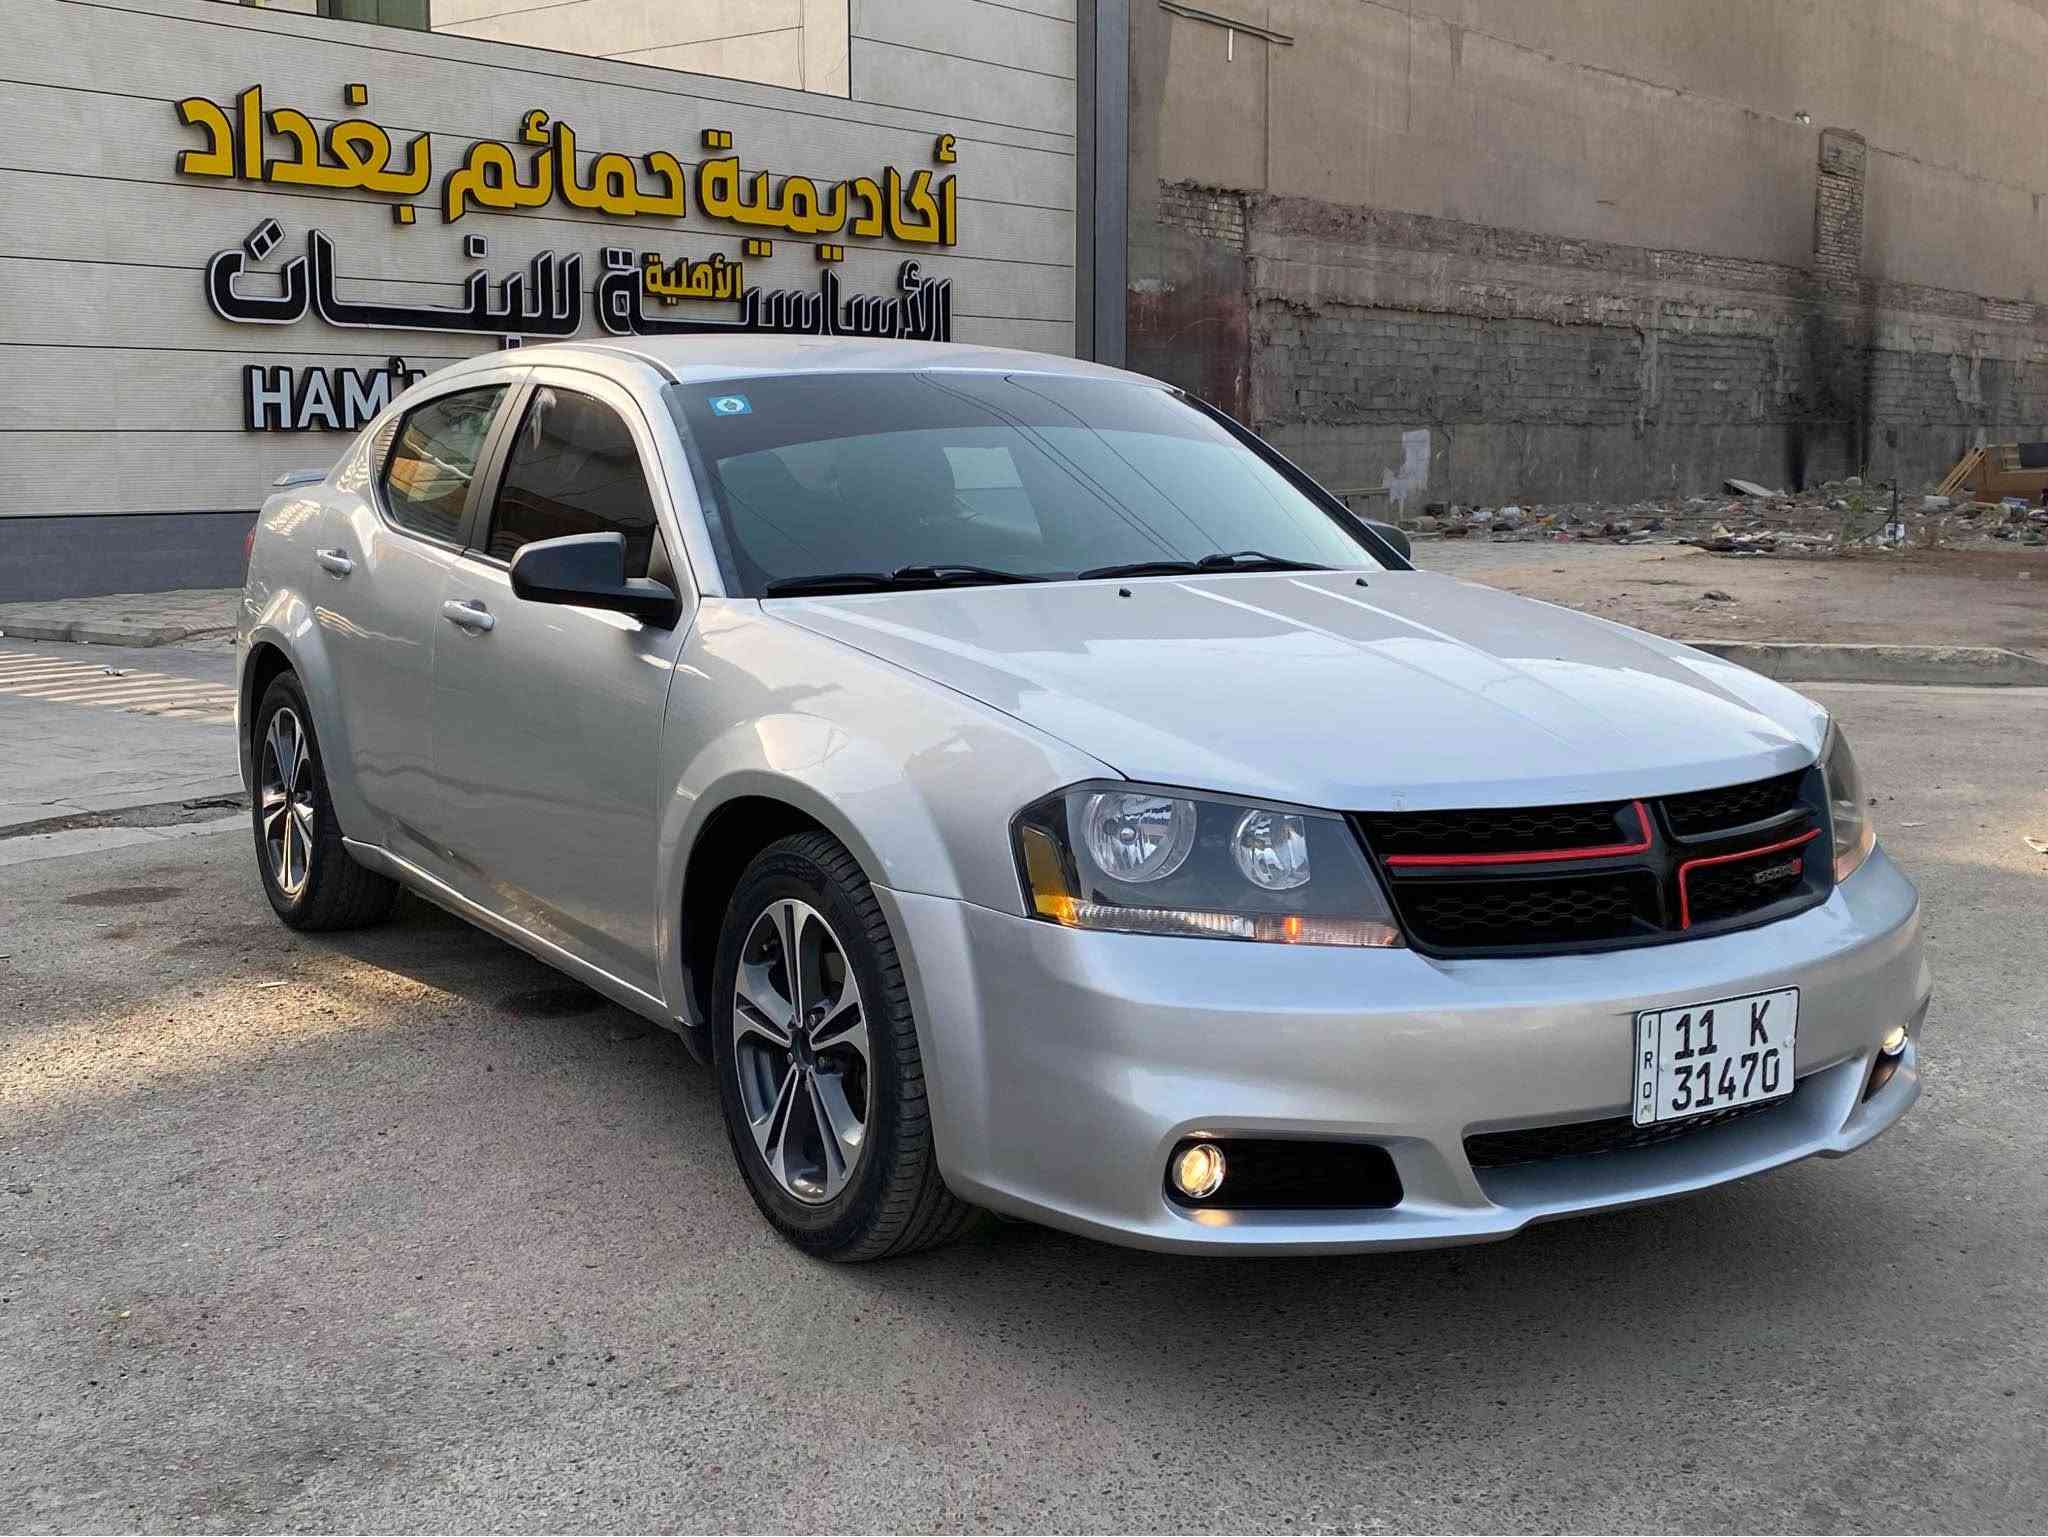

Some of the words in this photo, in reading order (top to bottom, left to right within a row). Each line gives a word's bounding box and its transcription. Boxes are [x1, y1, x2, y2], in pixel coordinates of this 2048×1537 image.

[176, 83, 431, 224] بغداد
[442, 109, 686, 224] حمائم
[697, 129, 957, 262] أكاديمية
[206, 218, 582, 349] للبنات
[641, 253, 743, 305] الأهلية
[1672, 1048, 1780, 1110] 31470
[1675, 1009, 1717, 1059] 11
[1750, 1000, 1771, 1046] K
